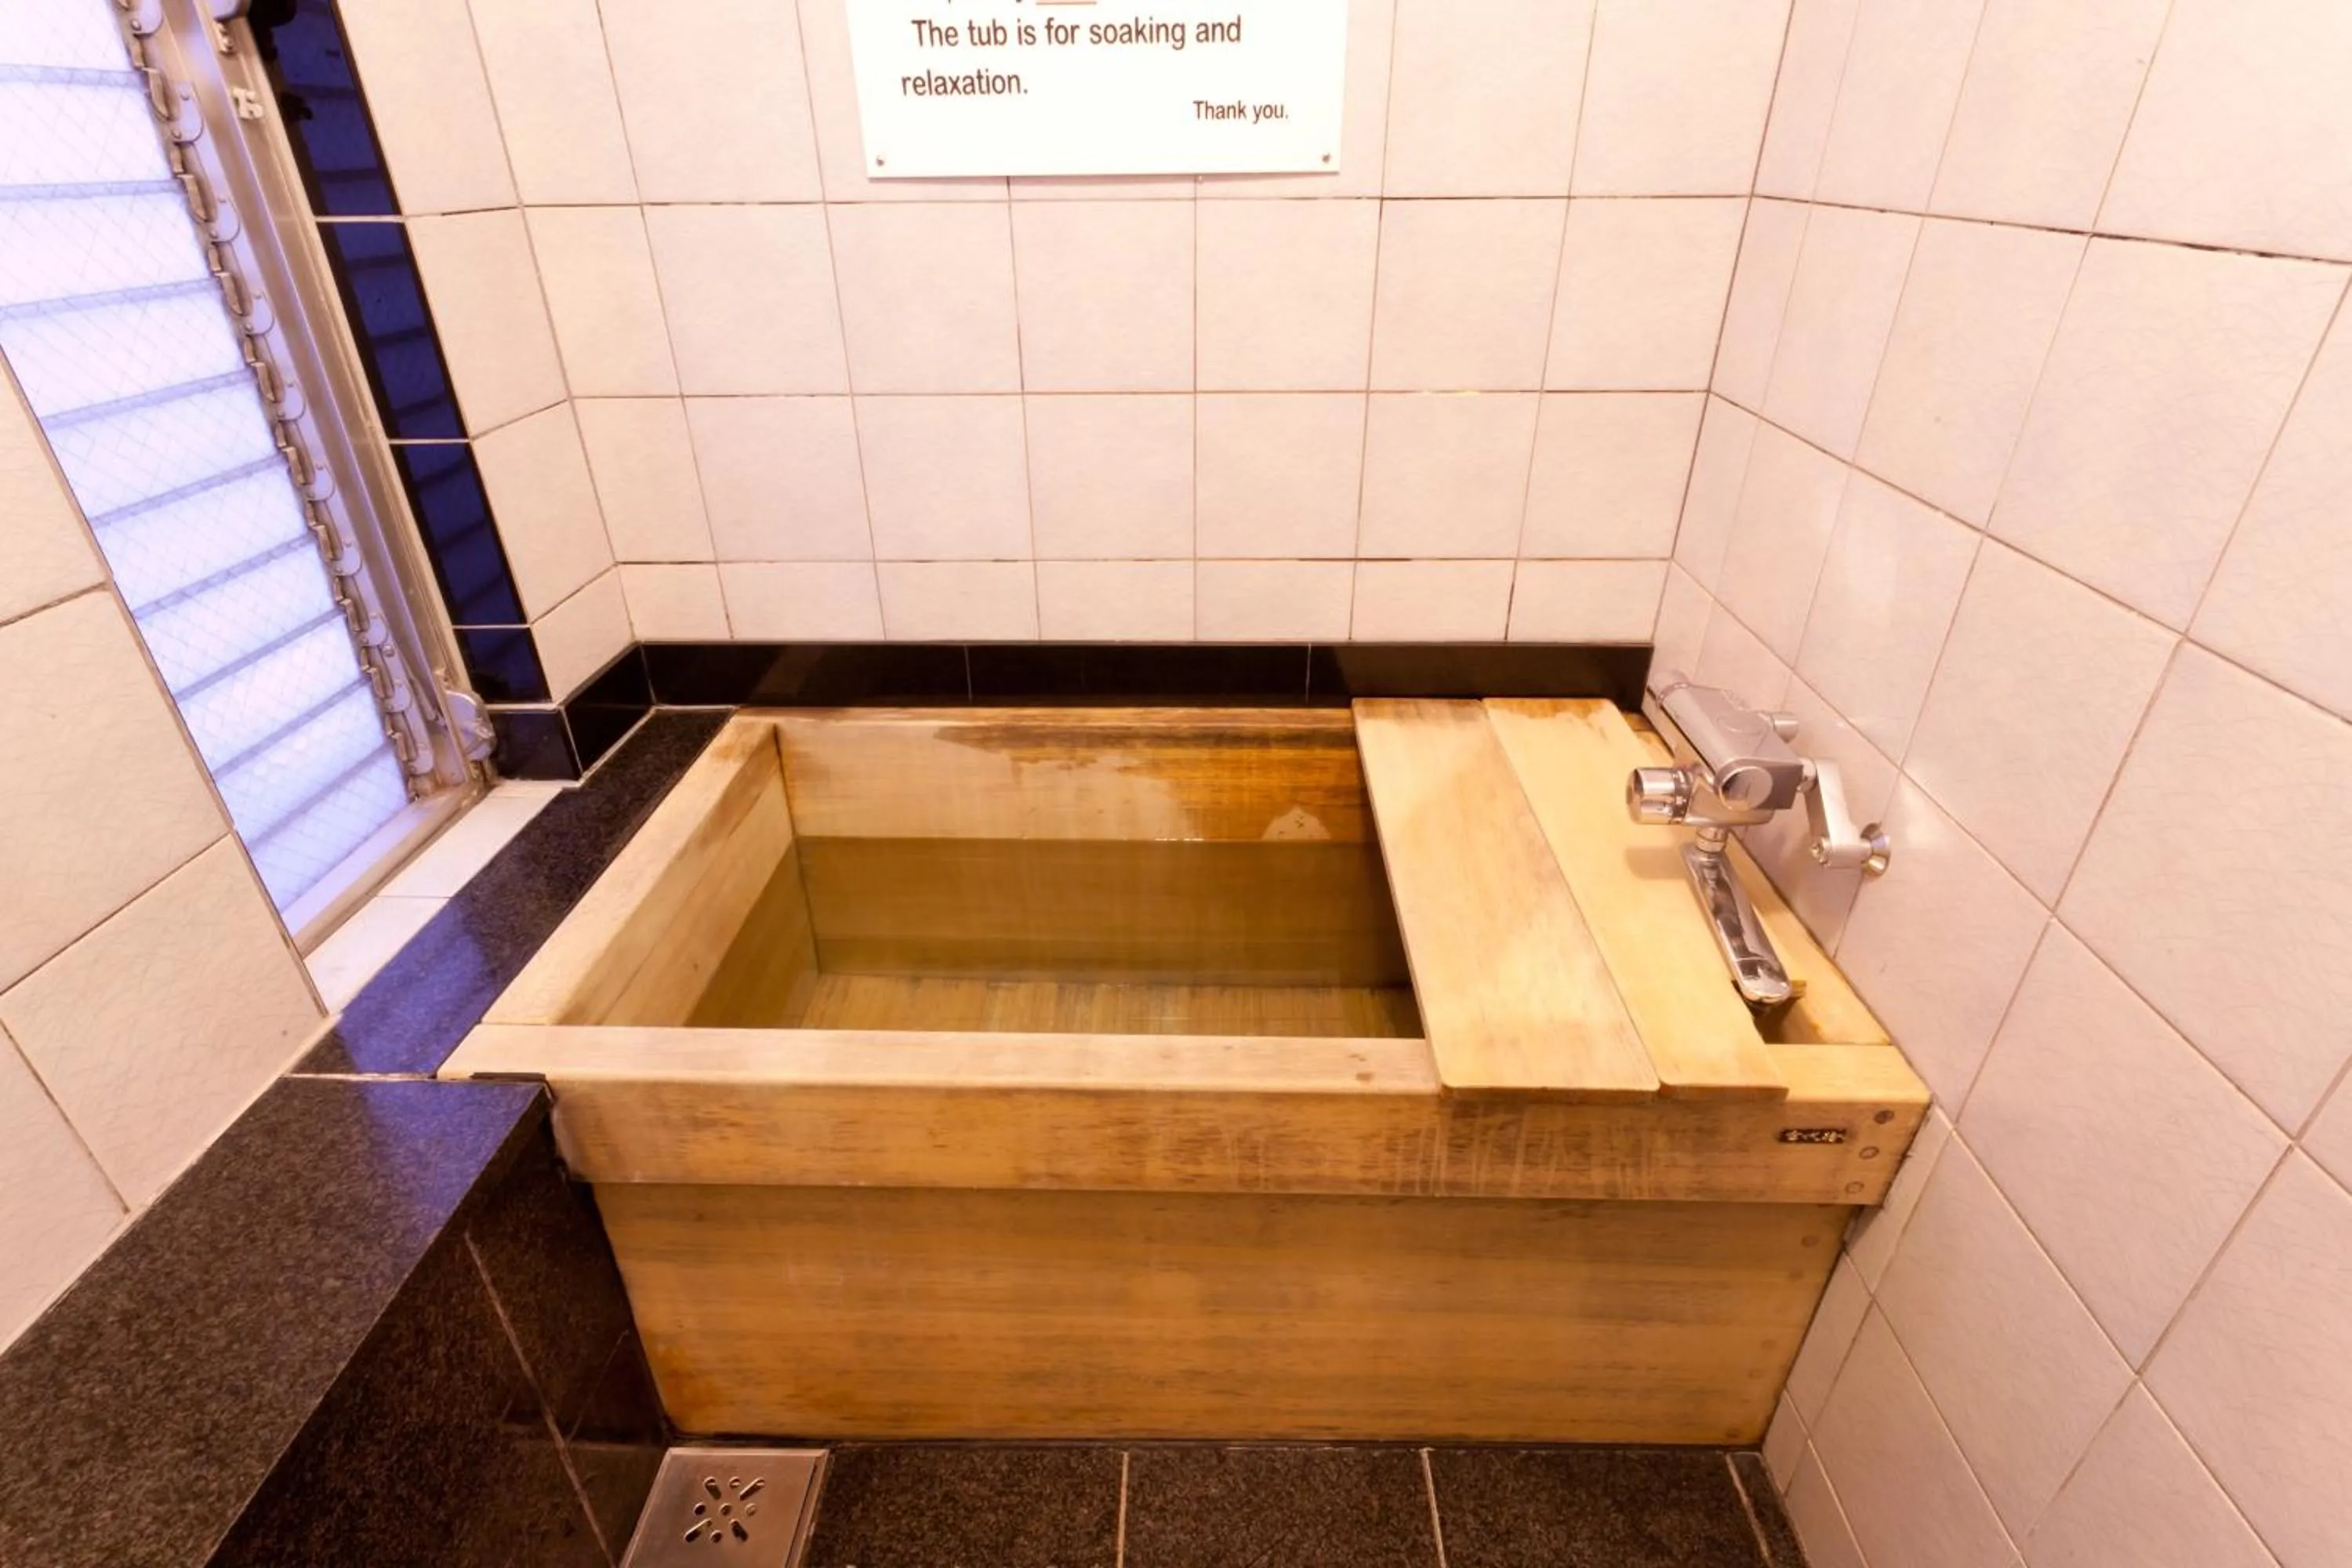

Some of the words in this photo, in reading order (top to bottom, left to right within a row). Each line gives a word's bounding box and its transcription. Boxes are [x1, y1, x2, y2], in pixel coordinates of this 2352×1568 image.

[911, 19, 959, 47] The
[967, 18, 1007, 46] tub
[1017, 18, 1037, 45] is
[1044, 16, 1080, 45] for
[1089, 16, 1185, 51] soaking
[1196, 15, 1241, 43] and
[901, 68, 1028, 96] relaxation.
[1192, 100, 1247, 120] Thank
[1253, 104, 1288, 125] you.
